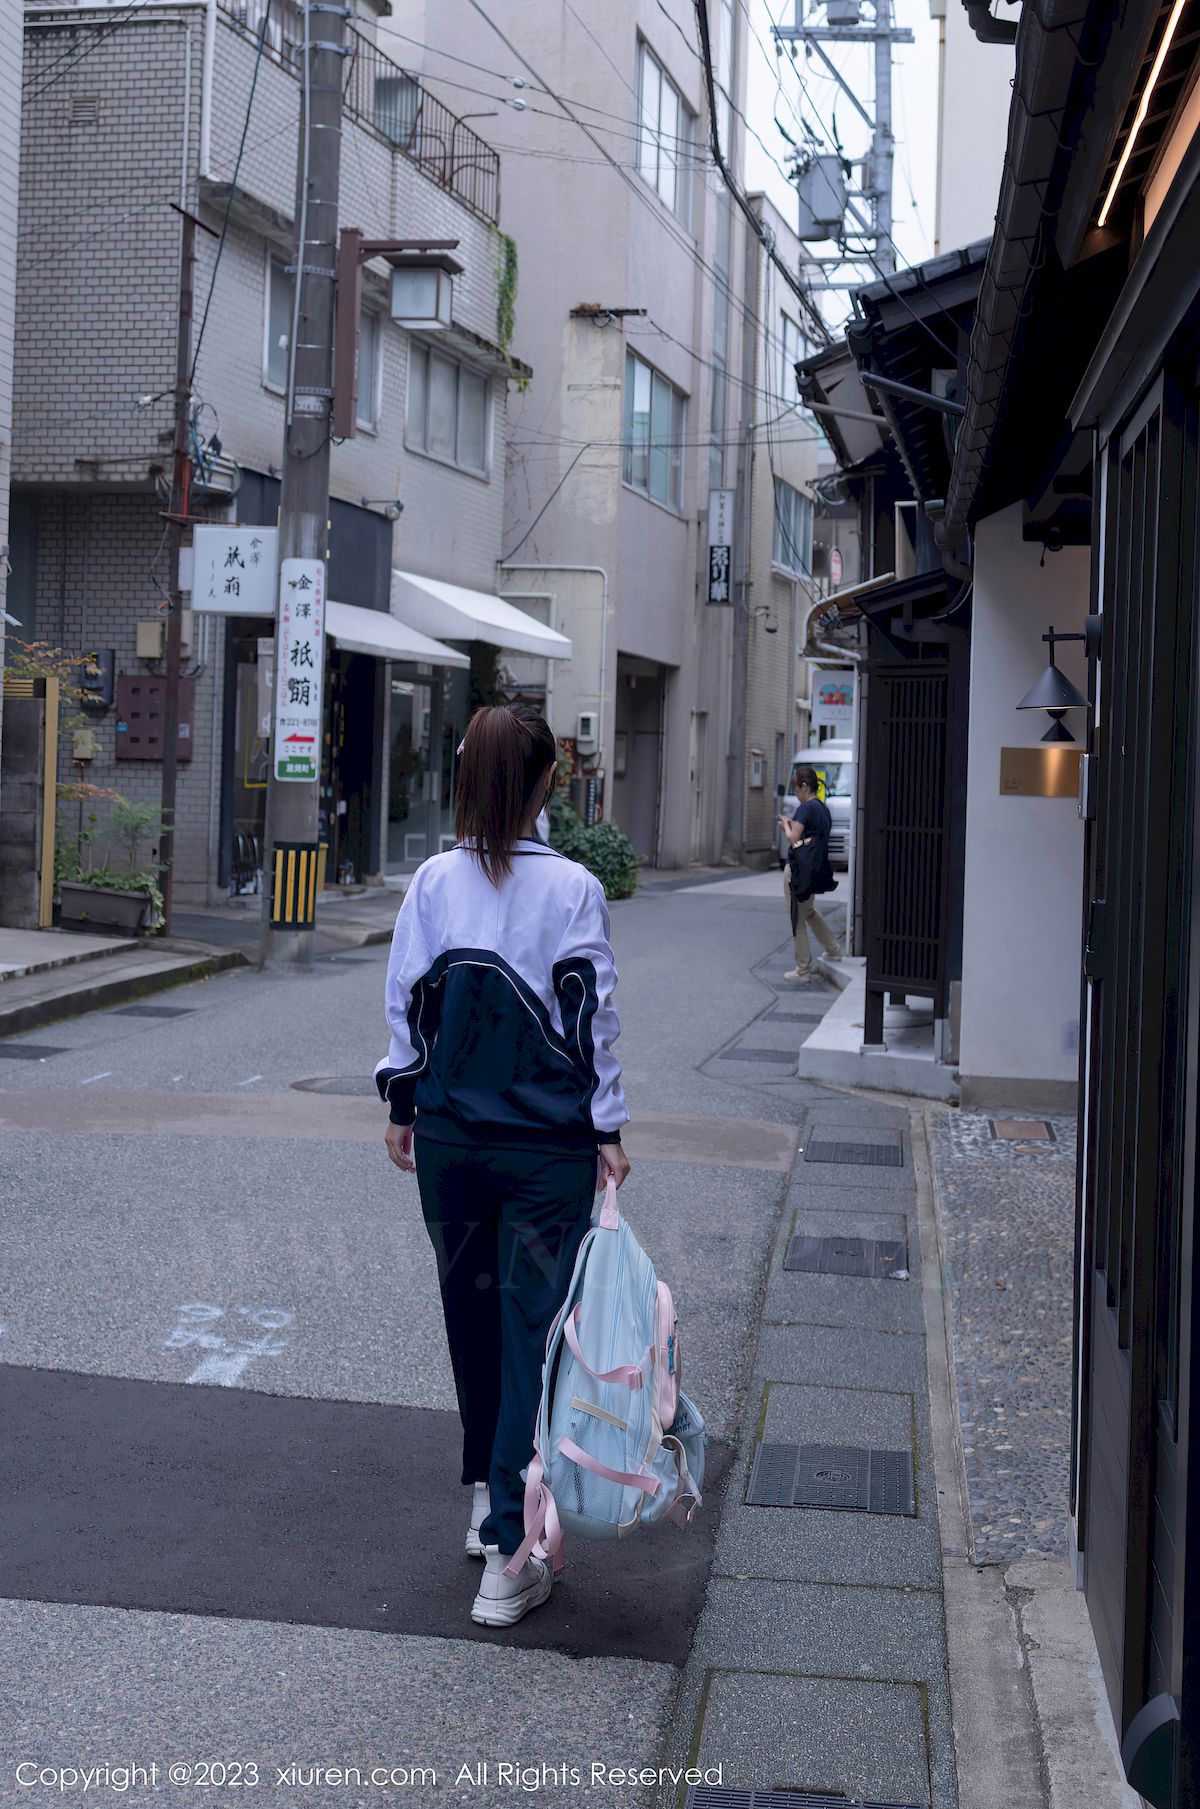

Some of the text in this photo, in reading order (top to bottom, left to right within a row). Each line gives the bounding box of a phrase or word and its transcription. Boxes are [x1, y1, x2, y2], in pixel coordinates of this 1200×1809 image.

[295, 573, 313, 620] 金澤
[284, 745, 312, 753] ここです
